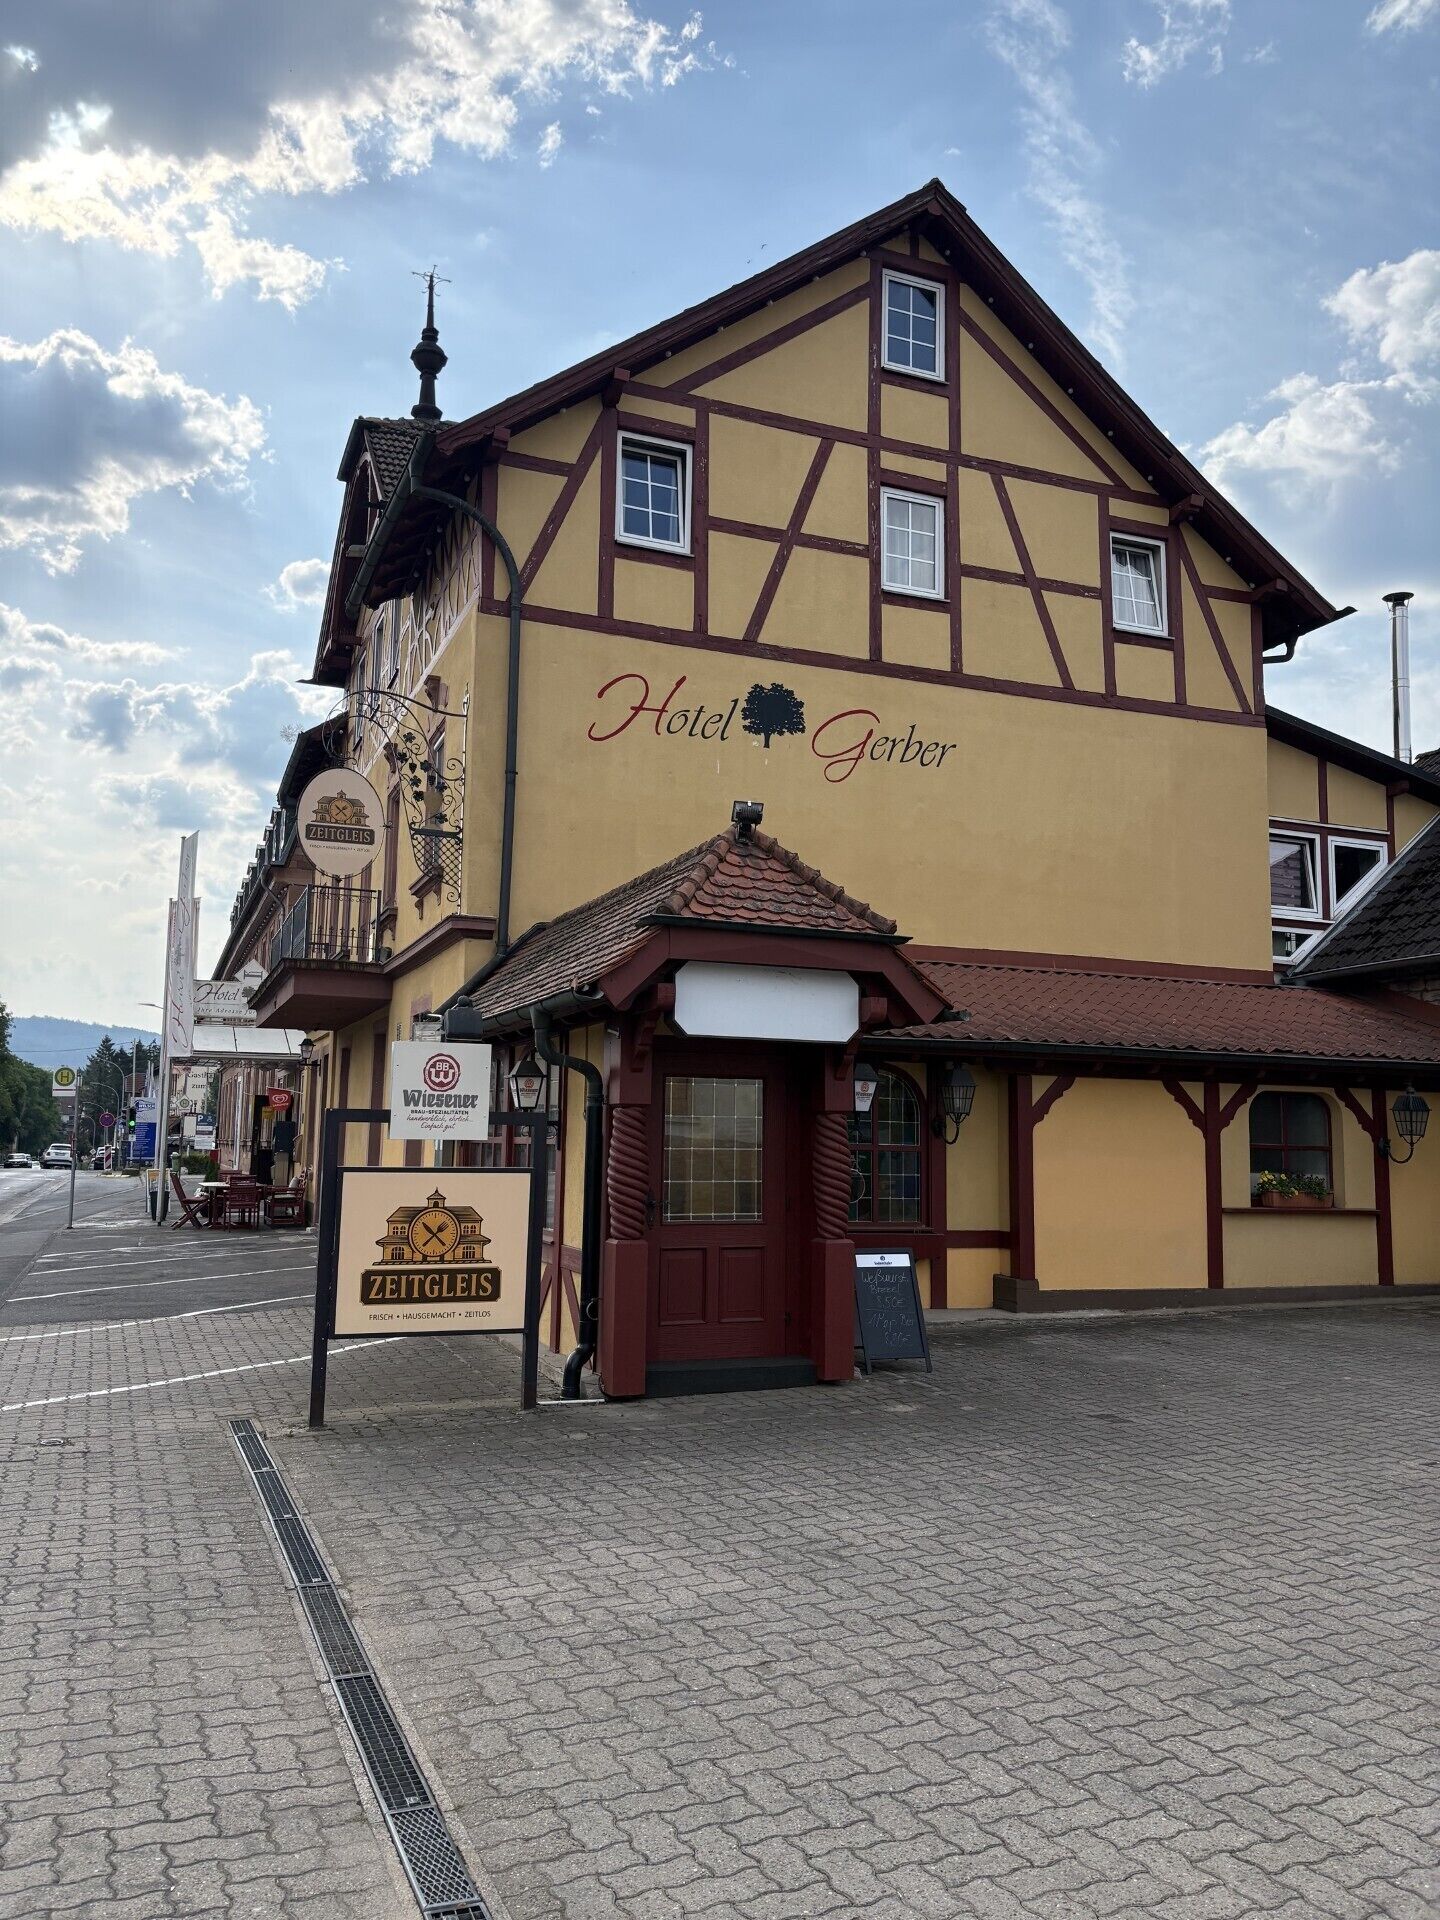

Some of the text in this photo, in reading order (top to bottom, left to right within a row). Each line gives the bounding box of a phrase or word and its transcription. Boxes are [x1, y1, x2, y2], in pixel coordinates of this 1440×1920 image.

[588, 674, 957, 782] Hotel Gerber
[309, 827, 370, 843] ZEITGLEIS
[193, 983, 239, 1003] Hotel
[402, 1089, 479, 1109] Wiesener
[369, 1272, 493, 1299] ZEITGLEIS
[368, 1310, 491, 1321] FRISCH HAUSGEMACHT ZEITLOS
